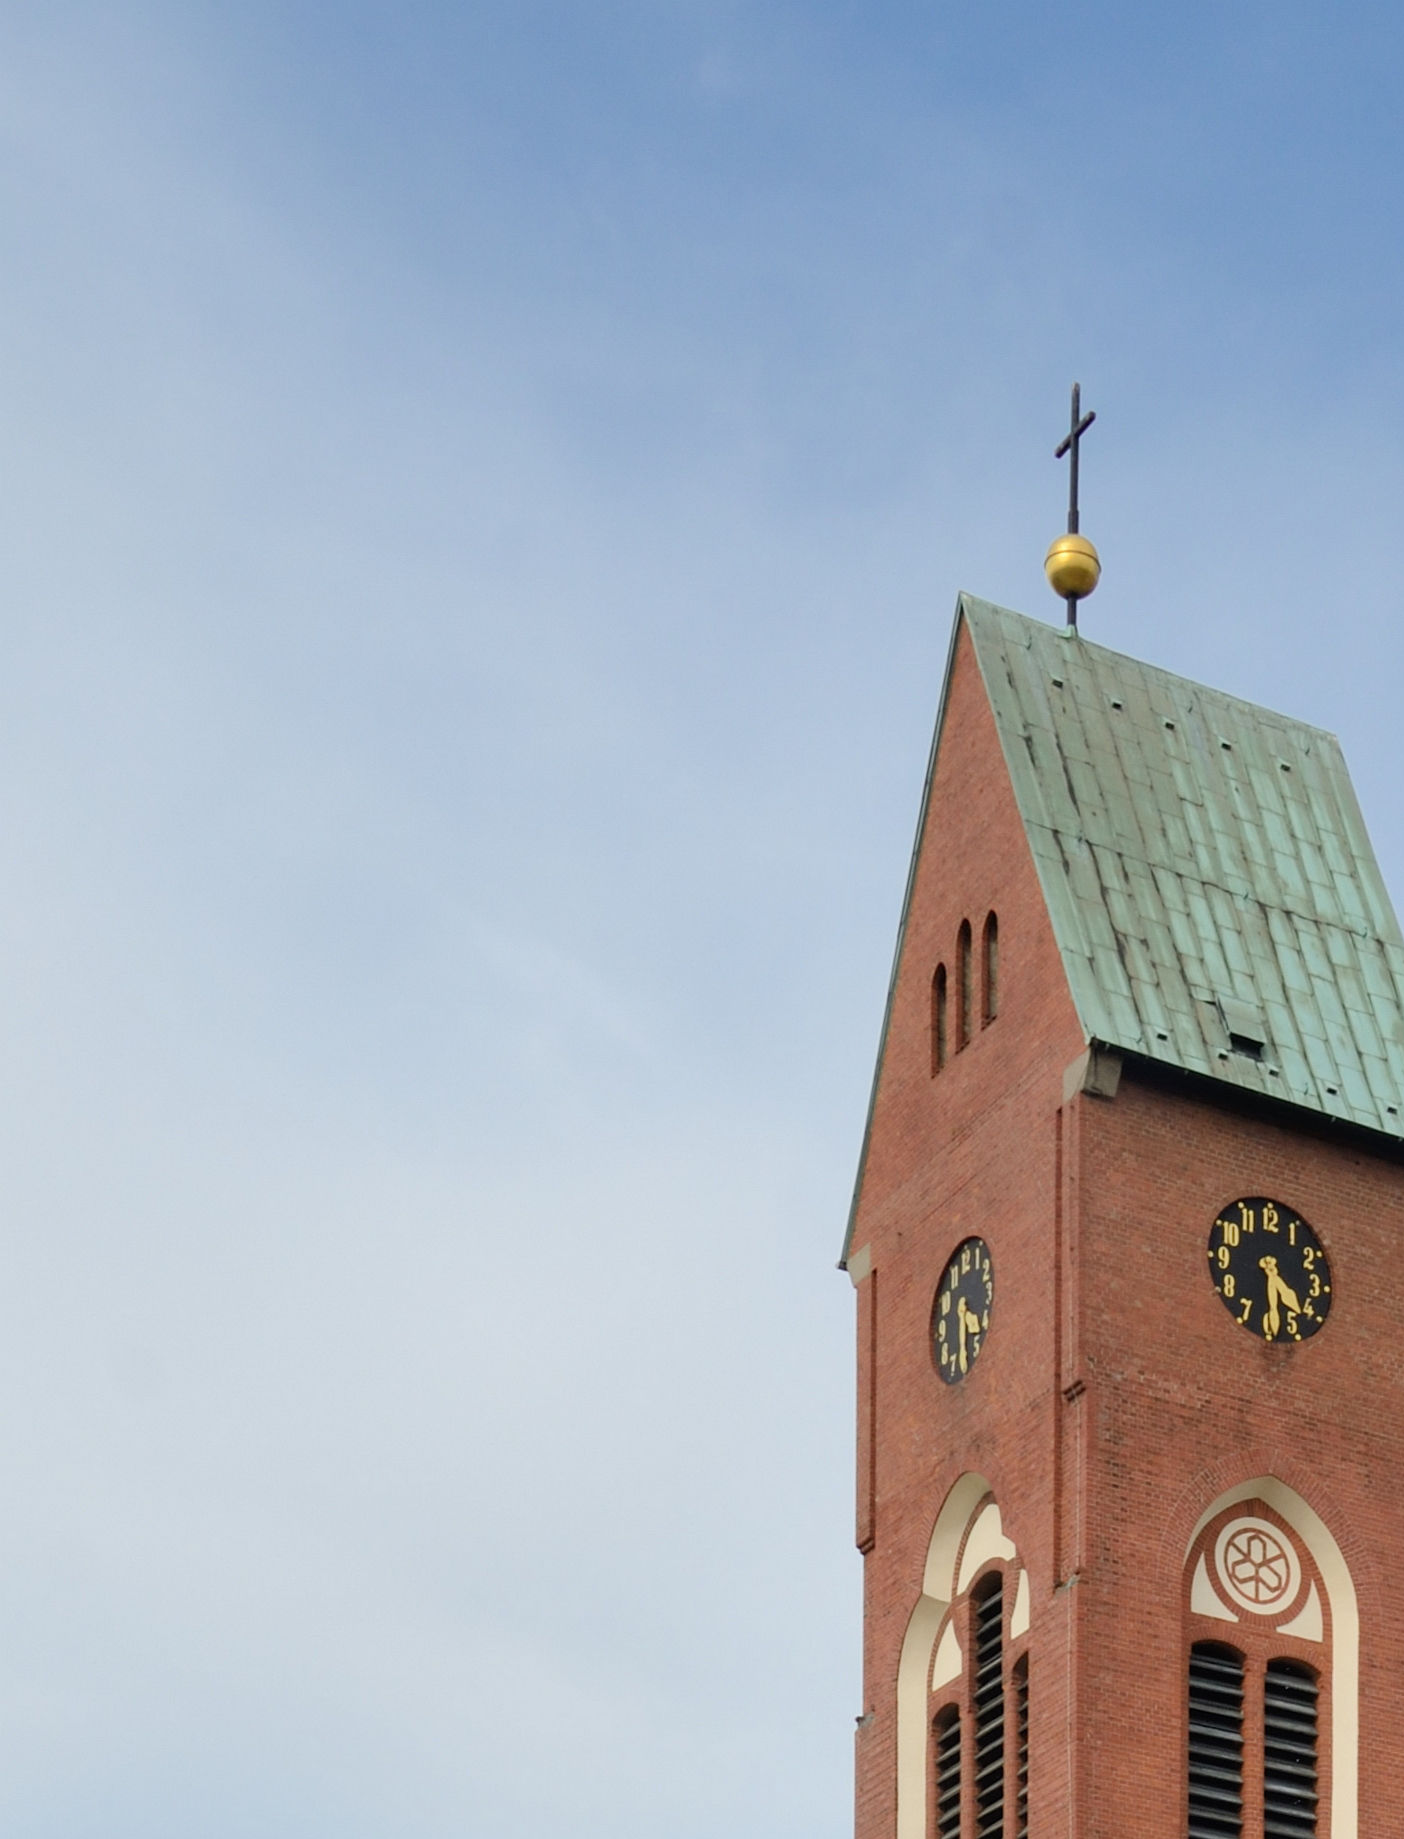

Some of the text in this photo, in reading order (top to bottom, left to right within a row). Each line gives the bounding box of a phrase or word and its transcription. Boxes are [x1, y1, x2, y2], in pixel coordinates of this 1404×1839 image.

[1242, 1207, 1254, 1233] 11
[1262, 1207, 1279, 1233] 12
[1223, 1221, 1240, 1247] 10
[1288, 1222, 1295, 1246] 1
[961, 1249, 971, 1275] 12
[975, 1247, 980, 1270] 1
[982, 1258, 990, 1282] 2
[1217, 1246, 1230, 1270] 9
[1303, 1246, 1314, 1270] 2
[950, 1265, 959, 1290] 11
[1223, 1274, 1235, 1298] 8
[1309, 1274, 1320, 1297] 3
[986, 1281, 993, 1306] 3
[982, 1309, 989, 1331] 4
[1240, 1297, 1253, 1321] 7
[1302, 1298, 1314, 1320] 4
[938, 1319, 946, 1343] 9
[1287, 1311, 1298, 1334] 5
[941, 1342, 948, 1366] 8
[973, 1334, 980, 1358] 5
[949, 1352, 957, 1377] 7
